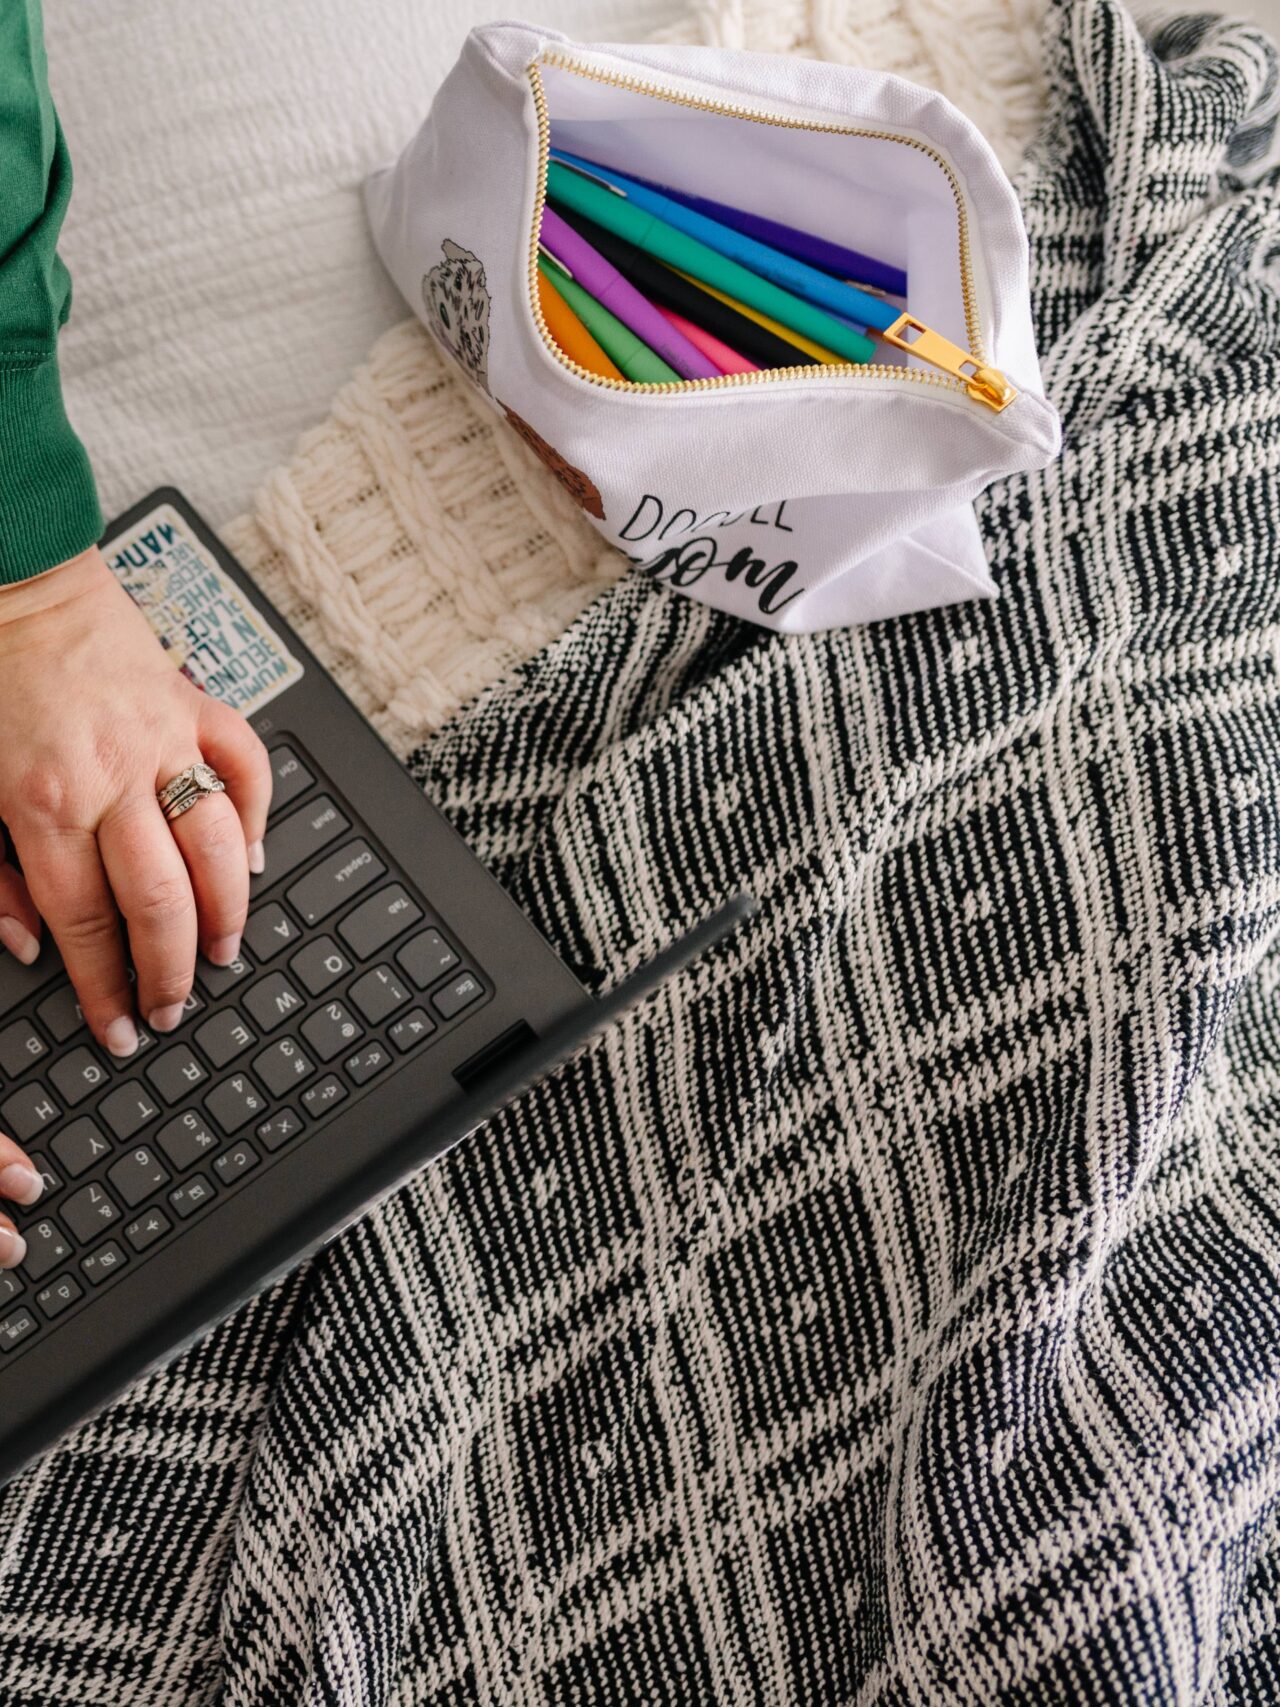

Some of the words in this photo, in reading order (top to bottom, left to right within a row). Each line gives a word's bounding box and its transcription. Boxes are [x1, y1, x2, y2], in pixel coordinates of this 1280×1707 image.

[150, 570, 227, 635] WHERE
[168, 589, 245, 654] PLACES
[186, 631, 236, 677] ALL
[203, 633, 280, 699] BELONG
[278, 759, 298, 777] Ctrl
[311, 808, 336, 829] Shift
[334, 852, 372, 882] CapsLk
[387, 898, 409, 914] Tab
[274, 920, 290, 937] A
[230, 959, 246, 974] S
[323, 955, 343, 973] Q
[376, 970, 388, 983] 1
[391, 986, 401, 999] !
[455, 979, 474, 995] Esc
[275, 991, 297, 1013] W
[326, 1004, 341, 1020] 2
[231, 1026, 249, 1045] E
[341, 1022, 355, 1037] @
[25, 1036, 43, 1054] B
[279, 1040, 294, 1056] 3
[182, 1062, 201, 1080] R
[294, 1058, 305, 1073] #
[82, 1065, 100, 1083] G
[232, 1079, 243, 1093] 4
[34, 1100, 53, 1120] H
[137, 1101, 153, 1118] T
[246, 1096, 257, 1108] $
[183, 1114, 197, 1130] 5
[89, 1138, 104, 1154] Y
[195, 1131, 211, 1146] %
[135, 1150, 149, 1165] 6
[40, 1171, 56, 1190] U
[89, 1187, 101, 1203] 7
[98, 1205, 112, 1217] &
[38, 1223, 52, 1238] 8
[4, 1280, 14, 1292] (
